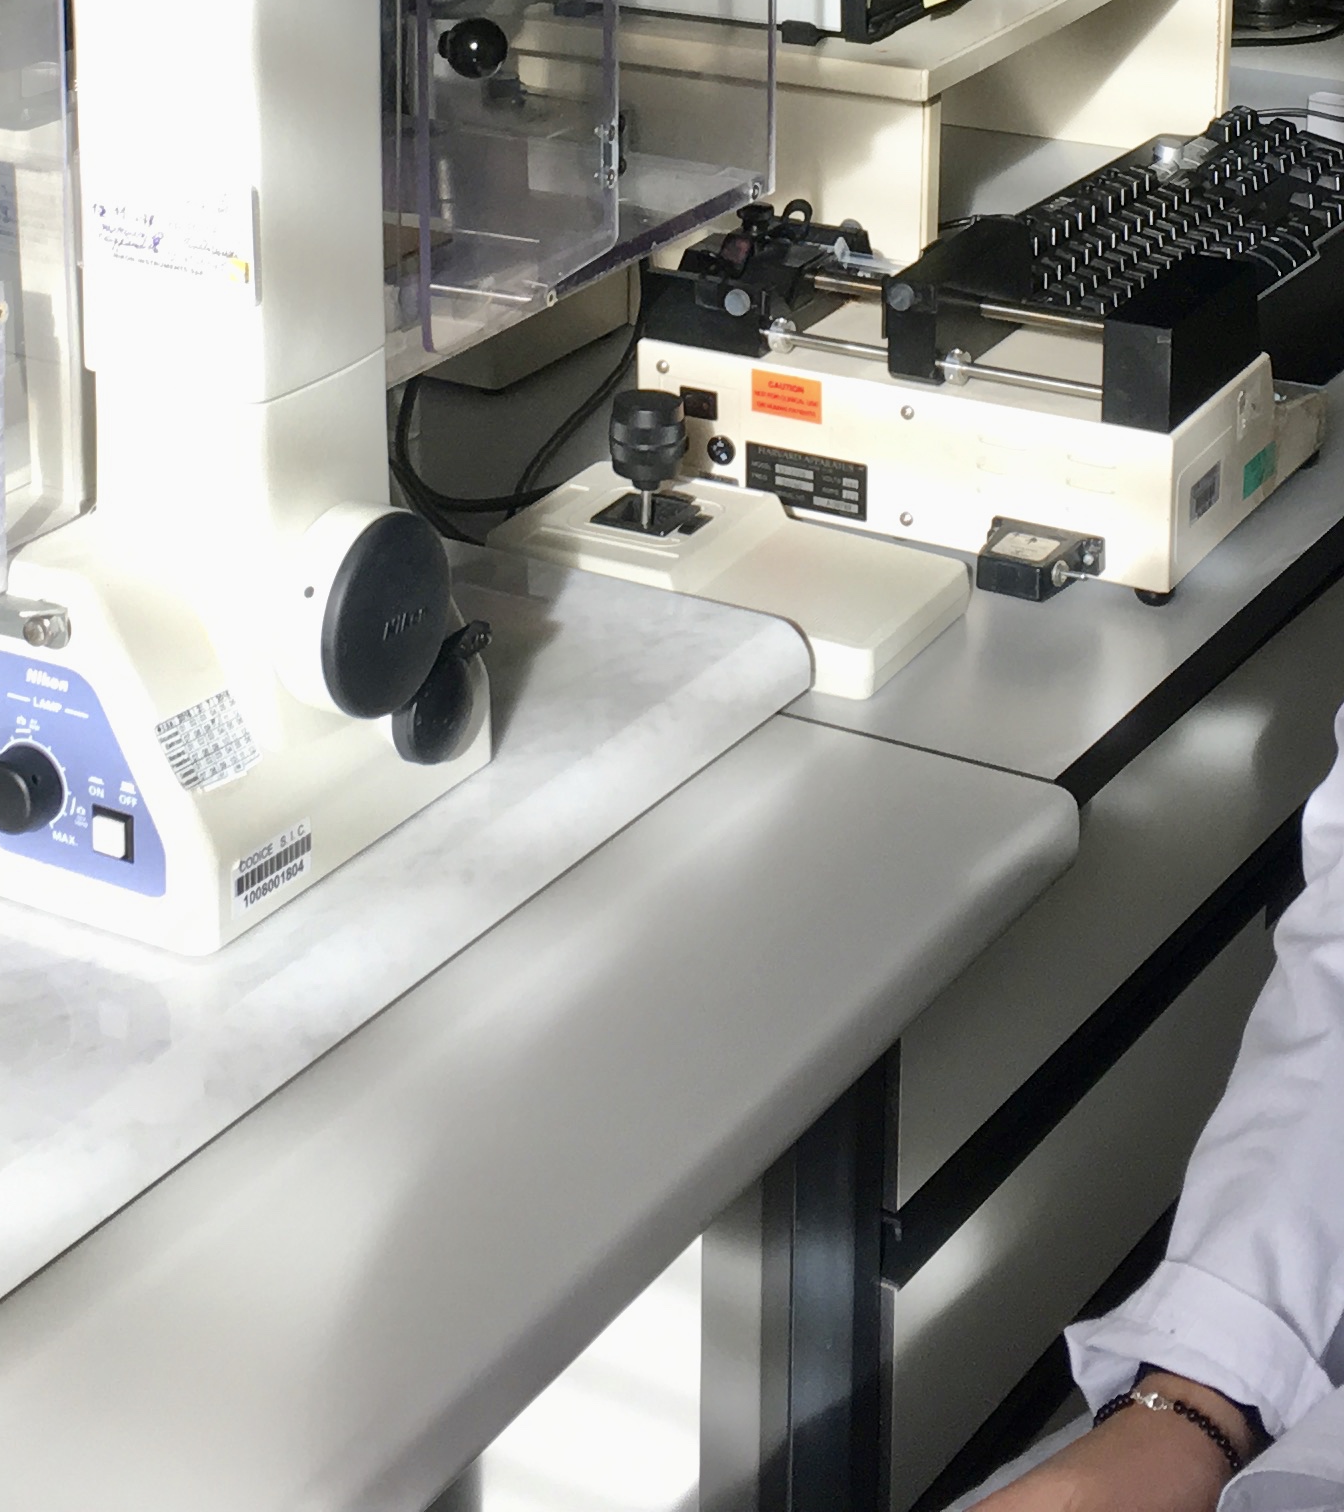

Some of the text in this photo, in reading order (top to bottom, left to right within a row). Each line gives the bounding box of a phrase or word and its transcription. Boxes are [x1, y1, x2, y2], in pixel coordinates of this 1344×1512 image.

[768, 380, 805, 394] CAUTION
[25, 667, 69, 693] Nikon
[32, 696, 63, 713] LAMP
[88, 785, 105, 799] ON
[118, 794, 138, 808] OFF
[239, 842, 274, 873] CODICE
